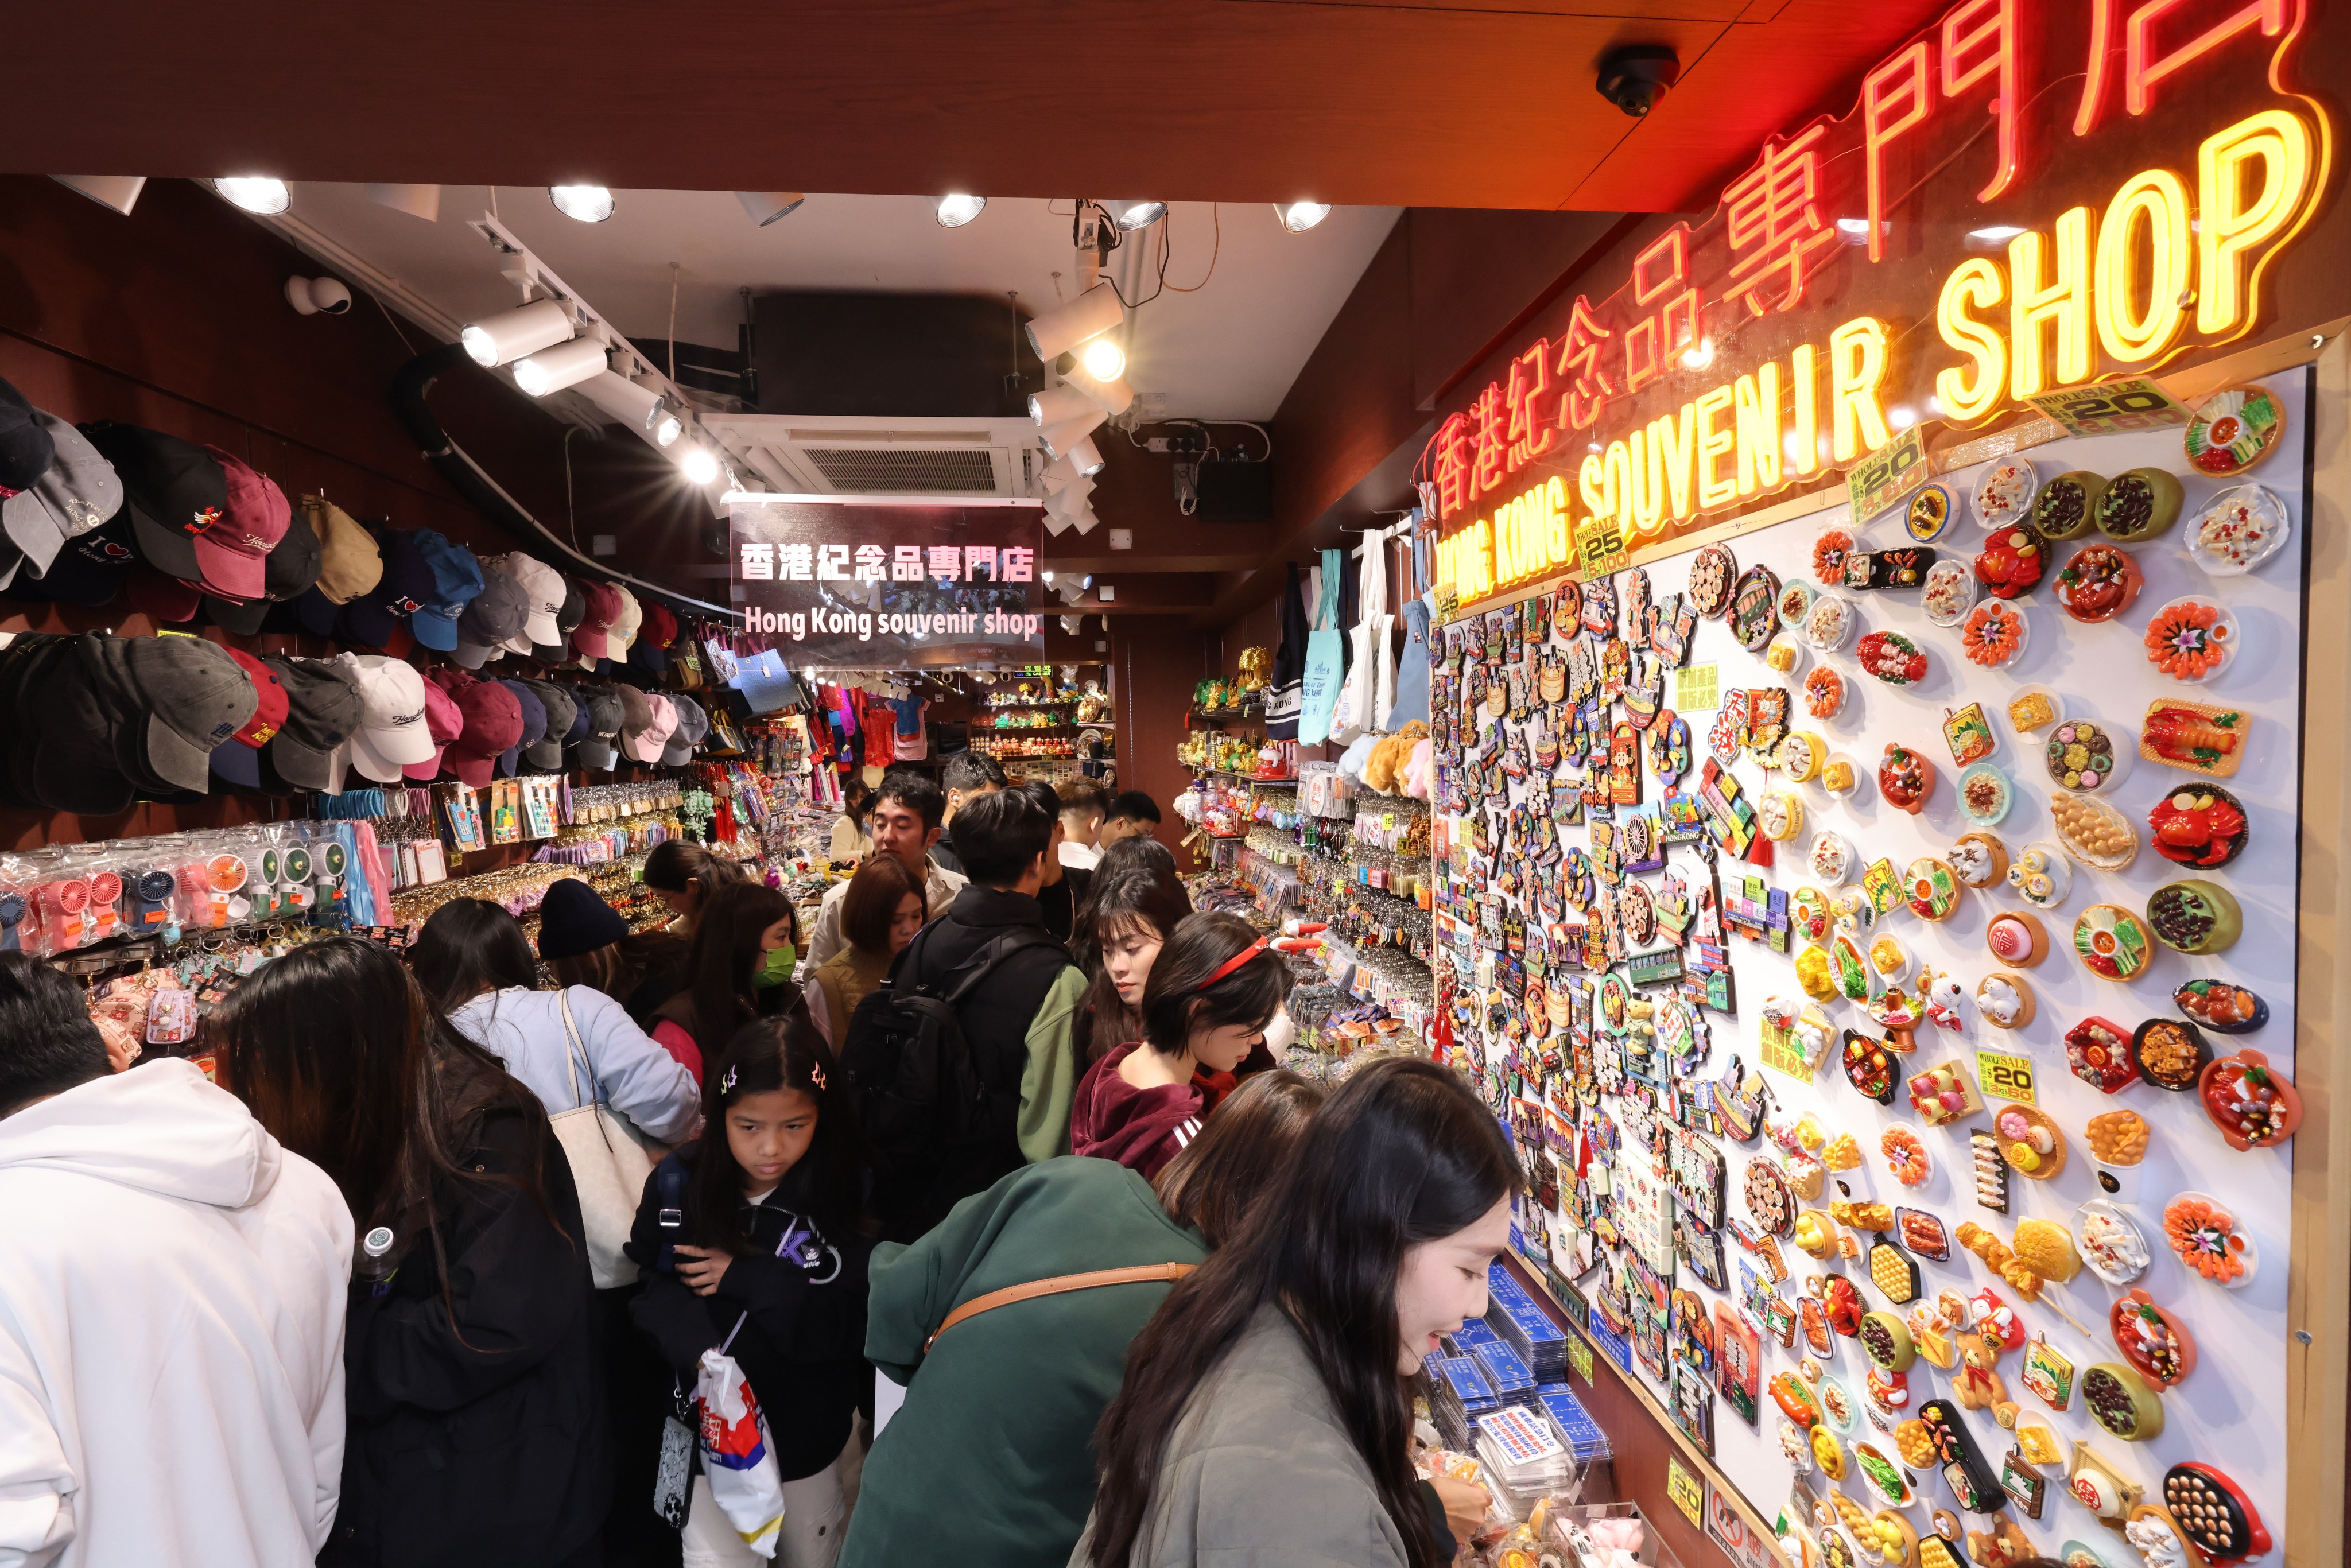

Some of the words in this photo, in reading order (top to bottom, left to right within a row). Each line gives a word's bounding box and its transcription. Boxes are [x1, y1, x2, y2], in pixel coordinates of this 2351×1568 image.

[1436, 519, 1491, 599] HONG
[1493, 475, 1570, 585] KONG
[1579, 316, 1891, 528] SOUVENIR
[1936, 109, 2313, 421] SHOP
[2033, 379, 2150, 407] WHOLESALE
[1850, 429, 1915, 482] WHOLESALE
[1577, 514, 1618, 542] WHOLESALE
[88, 535, 106, 548] I
[740, 543, 1034, 582] 香港紀念品專門店
[745, 607, 805, 641] Hong
[811, 607, 872, 641] Kong
[878, 607, 978, 634] souvenir
[984, 607, 1038, 641] shop
[1273, 697, 1292, 710] KONG
[1582, 792, 1594, 808] Hong
[1595, 791, 1608, 809] Kong
[459, 824, 471, 836] HK
[1866, 873, 1881, 894] HK
[1979, 1053, 2029, 1070] WHOLESALE
[1727, 1123, 1743, 1139] Kong
[1651, 1187, 1658, 1212] 香港
[1611, 1321, 1620, 1333] Kong
